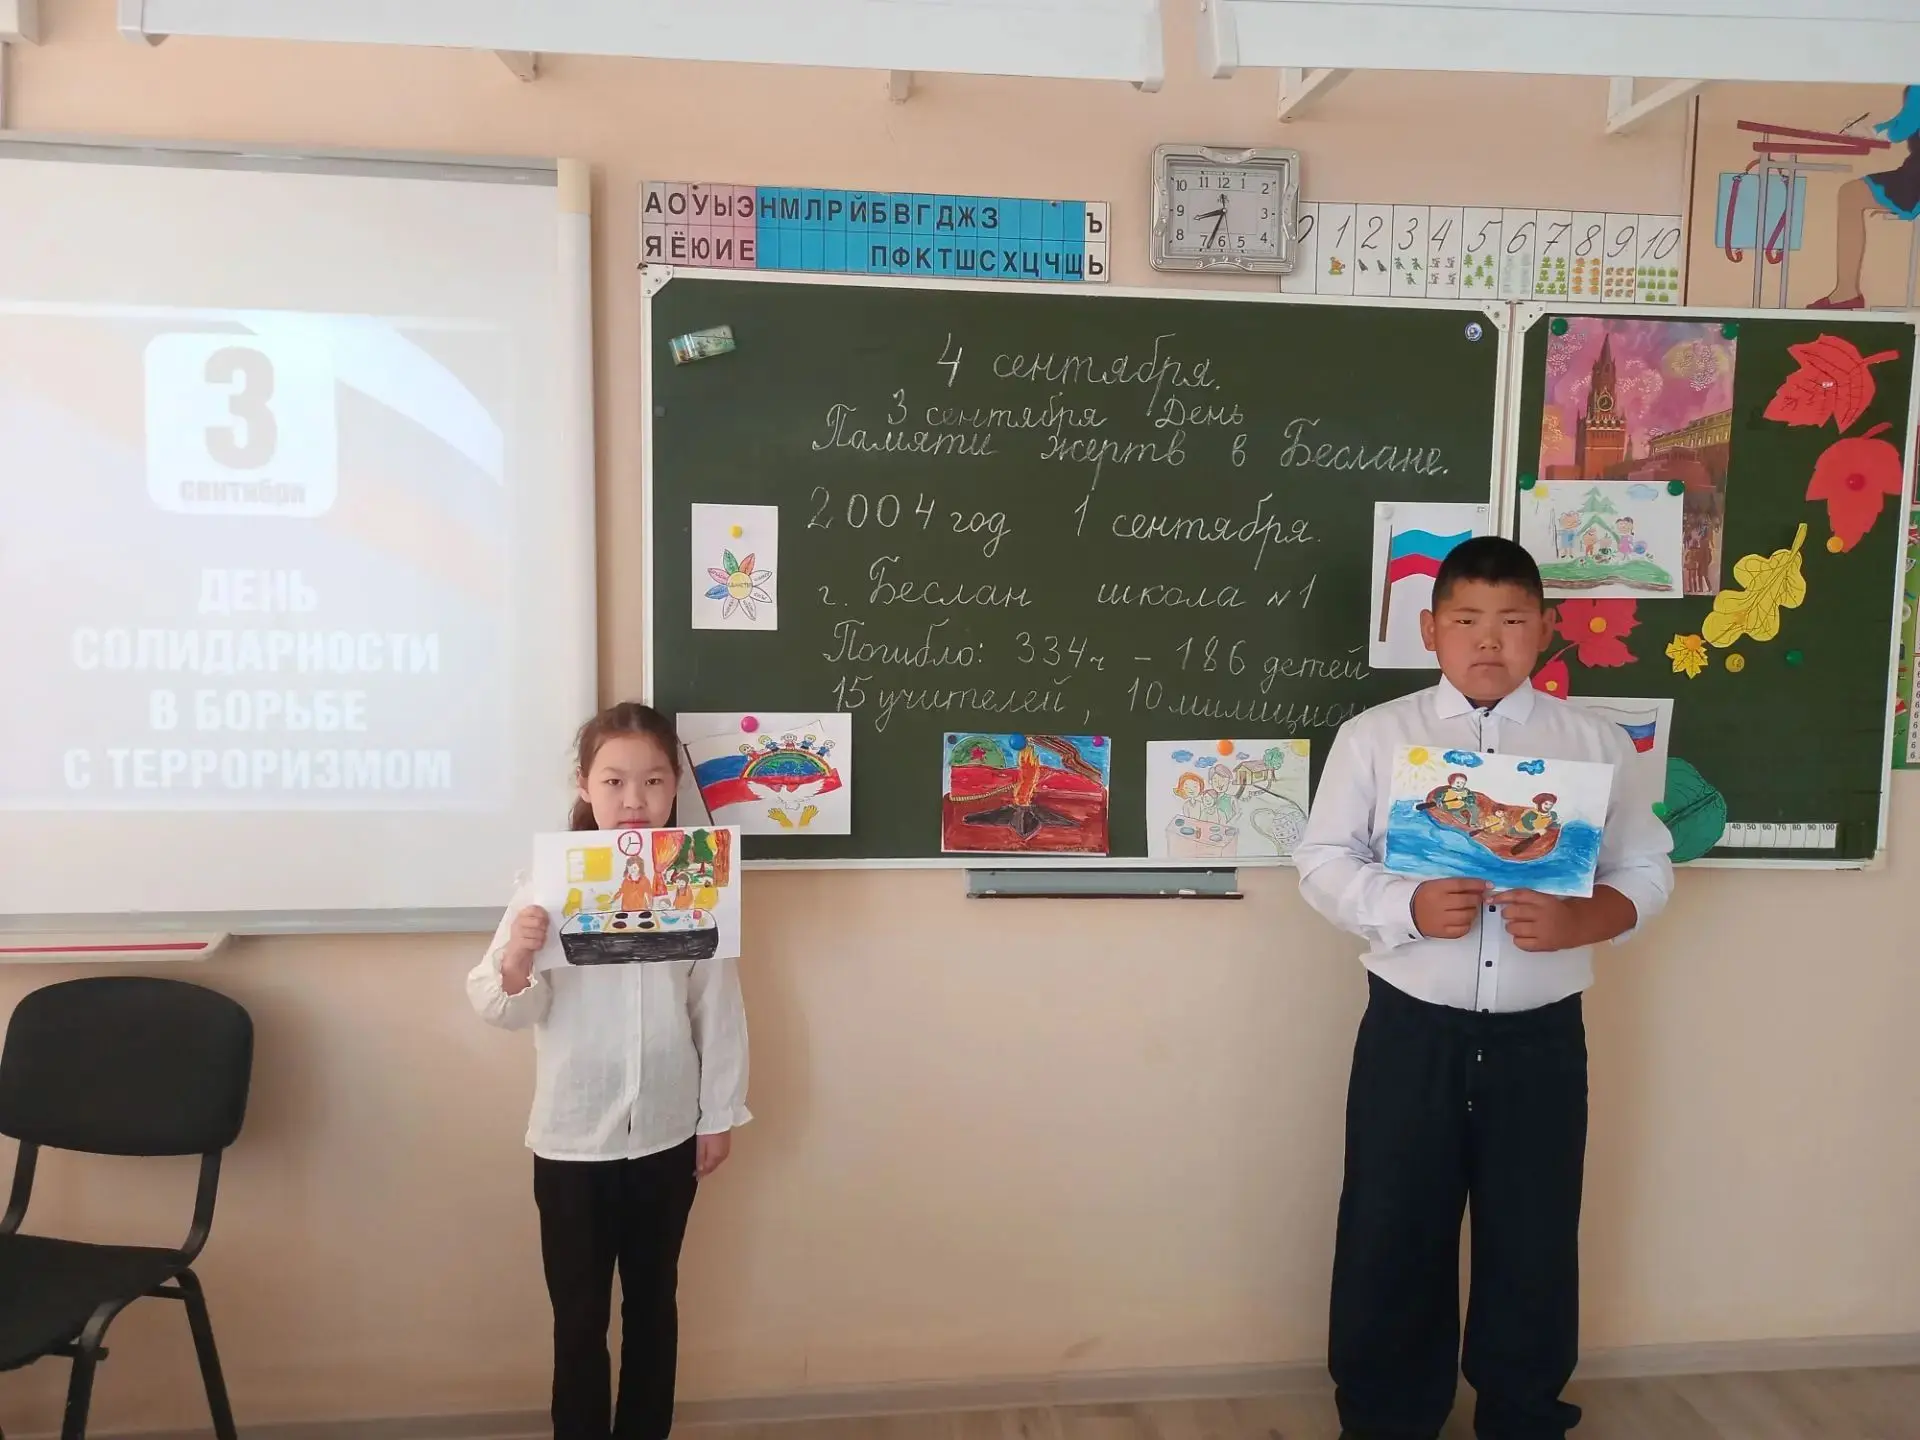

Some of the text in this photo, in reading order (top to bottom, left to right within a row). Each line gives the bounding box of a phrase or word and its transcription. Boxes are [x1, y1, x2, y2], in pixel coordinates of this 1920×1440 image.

[1175, 176, 1270, 195] 10 11 12 1 2
[1176, 204, 1269, 220] 9 3
[1176, 228, 1185, 241] 8
[1218, 235, 1226, 248] 6
[1237, 235, 1246, 248] 5
[1260, 231, 1268, 244] 4
[1336, 215, 1351, 248] 1
[1360, 216, 1384, 249] 2
[1398, 217, 1418, 250] 3
[1430, 218, 1453, 252] 4
[1467, 220, 1502, 253] 5
[1507, 221, 1535, 254] 6
[1545, 222, 1572, 255] 7
[1575, 224, 1601, 256] 8
[1607, 225, 1635, 258] 9
[1640, 227, 1682, 260] 10
[936, 332, 1221, 417] 4 сентября.
[204, 345, 279, 470] 3
[888, 388, 1244, 437] 3 сентября День
[812, 403, 998, 456] Памяти
[1231, 433, 1248, 468] в
[1280, 418, 1449, 475] Беслане.
[807, 486, 1321, 571] 2004 год 1 сентября.
[197, 567, 319, 616] ДЕНЬ
[818, 585, 848, 606] г.
[869, 556, 1033, 607] Беслан
[1097, 583, 1248, 608] школа
[70, 626, 440, 675] СОЛИДАРНОСТИ
[823, 618, 984, 668] Погибло:
[1176, 635, 1247, 675] 186
[1260, 645, 1370, 694] детей
[149, 688, 369, 732] В БОРЬБЕ
[832, 675, 873, 712] 15
[1127, 677, 1163, 712] 10
[63, 747, 452, 790] С ТЕРРОРИЗМОМ
